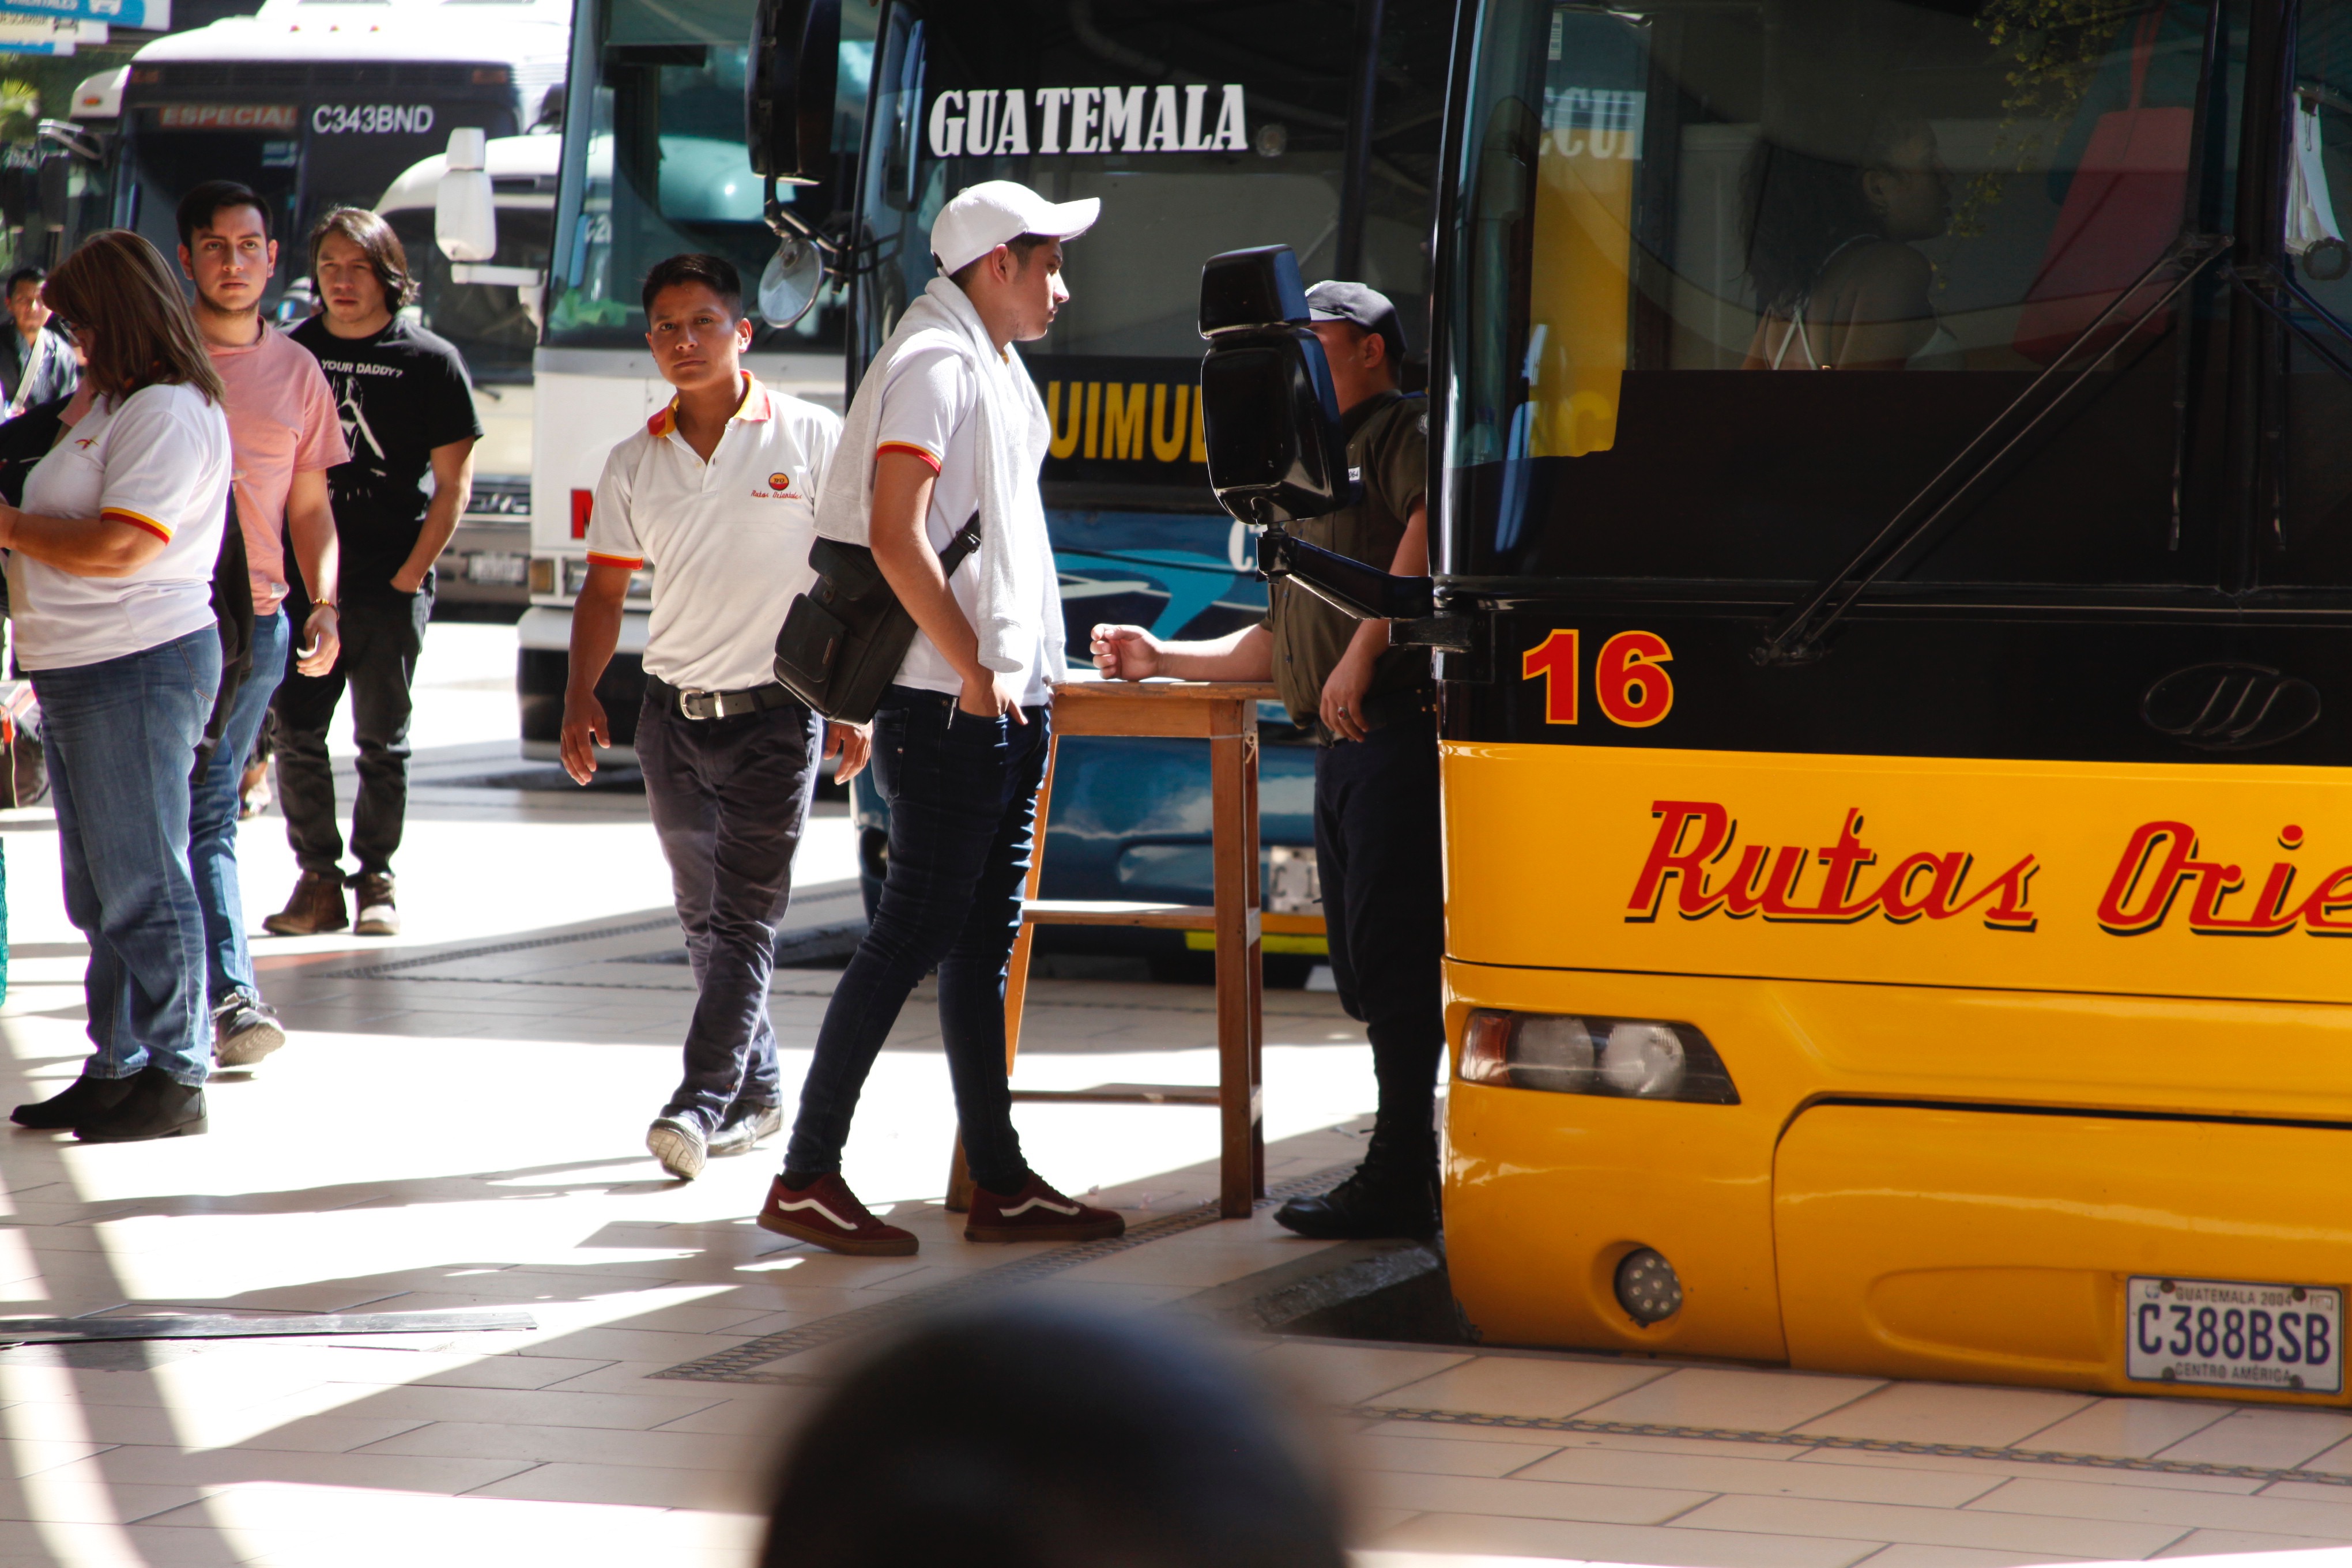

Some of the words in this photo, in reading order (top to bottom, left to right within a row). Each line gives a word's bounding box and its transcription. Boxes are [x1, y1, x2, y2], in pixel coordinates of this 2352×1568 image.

[162, 105, 297, 126] ESPECIAL
[312, 104, 434, 134] C343BND
[929, 84, 1248, 157] GUATEMALA
[321, 359, 352, 374] YOUR
[751, 489, 768, 498] Rutas
[1522, 628, 1673, 728] 16
[1623, 800, 2040, 932] Rutas
[2176, 1287, 2255, 1305] GUATEMALA
[2138, 1303, 2330, 1365] C388BSB
[2175, 1362, 2226, 1378] CENTRO
[2232, 1365, 2291, 1382] AMÉRICA
